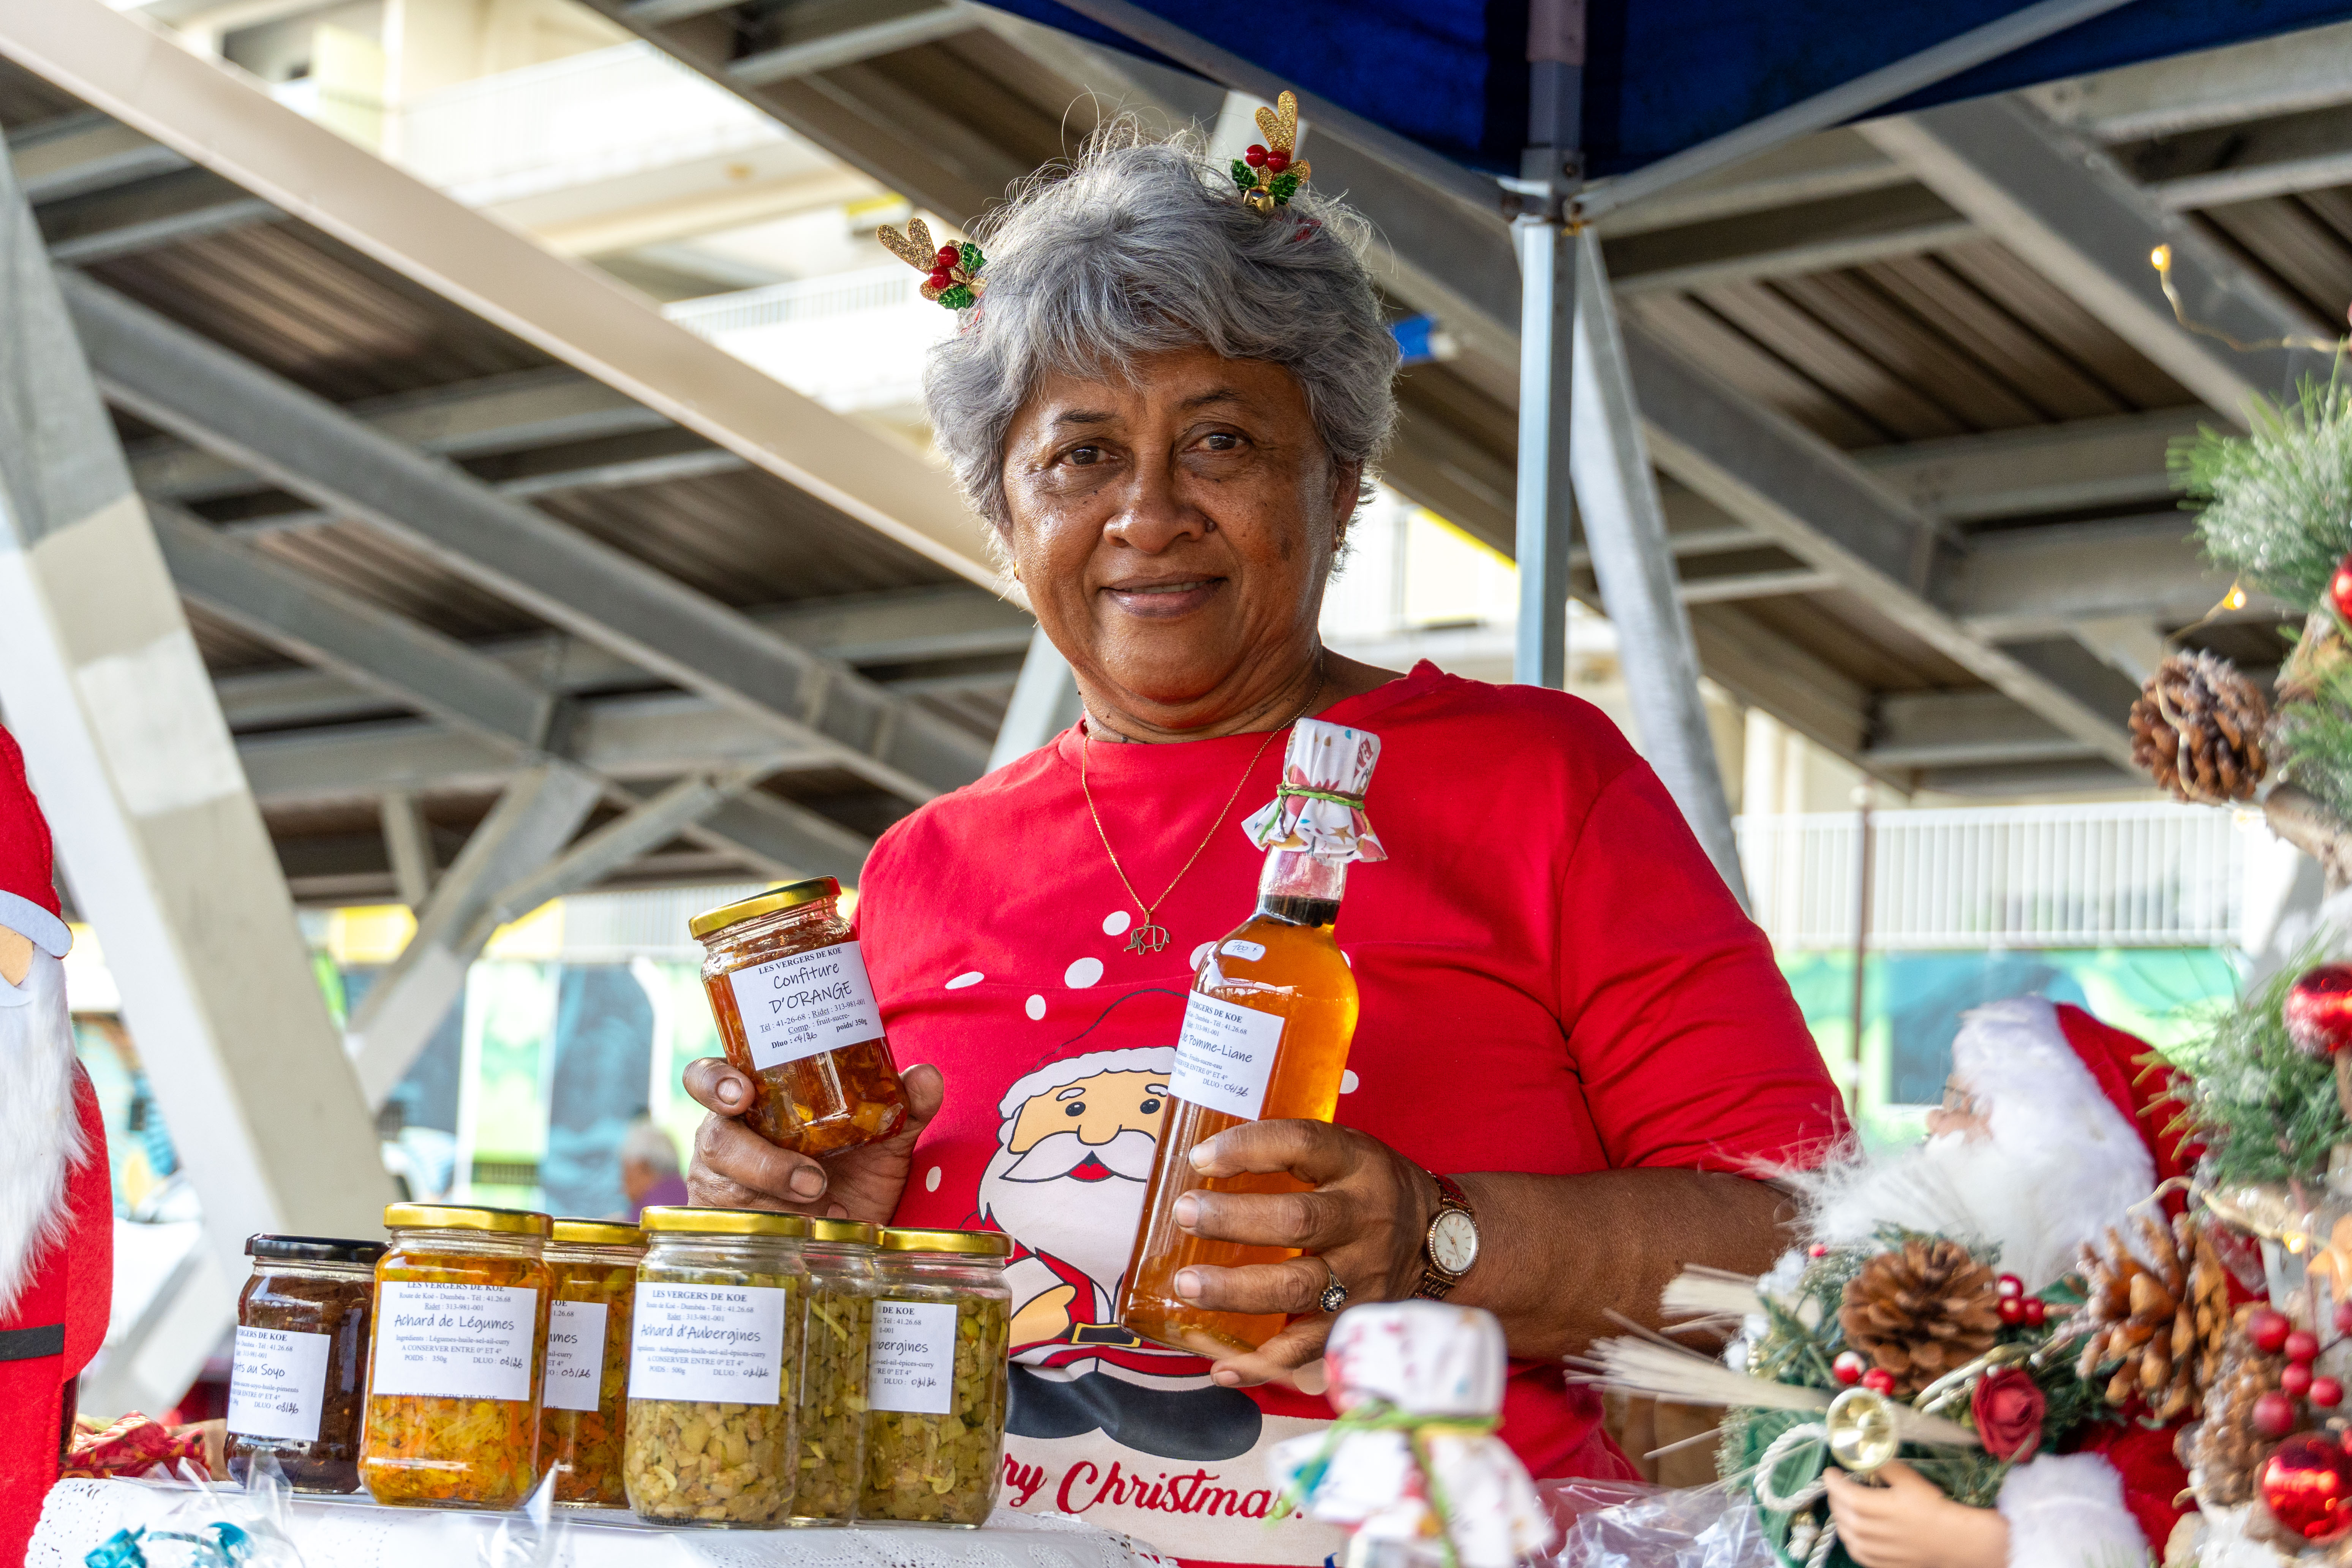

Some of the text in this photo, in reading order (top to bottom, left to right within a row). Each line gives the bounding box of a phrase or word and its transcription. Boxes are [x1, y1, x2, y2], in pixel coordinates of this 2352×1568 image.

[1233, 942, 1248, 953] 700
[759, 966, 774, 974] LES
[776, 954, 815, 969] VERGERS
[828, 947, 842, 956] KOE
[774, 963, 839, 988] Confiture
[769, 981, 852, 1014] D'ORANGE
[760, 1023, 771, 1033] Tél
[776, 1013, 806, 1027] 41-26-68
[812, 1008, 830, 1018] Ridet
[834, 999, 865, 1012] 313-981-001
[1192, 1000, 1213, 1014] VERGERS
[1214, 1008, 1223, 1017] DE
[1225, 1012, 1242, 1023] KOE
[788, 1024, 811, 1035] Comp.
[836, 1020, 854, 1032] poids/
[1195, 1013, 1209, 1023] Dumbéa
[1225, 1024, 1247, 1034] 41.26.68
[1195, 1024, 1219, 1036] 313-981-001
[771, 1040, 788, 1048] Dluo
[1189, 1034, 1252, 1063] Pomme-Liane
[1189, 1054, 1222, 1069] Fruits-sucre-eau
[1190, 1064, 1205, 1074] ENTRE
[1203, 1078, 1219, 1088] DLUO
[667, 1290, 708, 1299] VERGERS
[726, 1293, 747, 1302] KOE
[394, 1314, 514, 1333] Achard de Légumes
[641, 1323, 673, 1336] Achard
[270, 1333, 287, 1341] KOE
[247, 1365, 257, 1374] au
[261, 1364, 285, 1379] Soyo
[561, 1367, 591, 1378] 03/26
